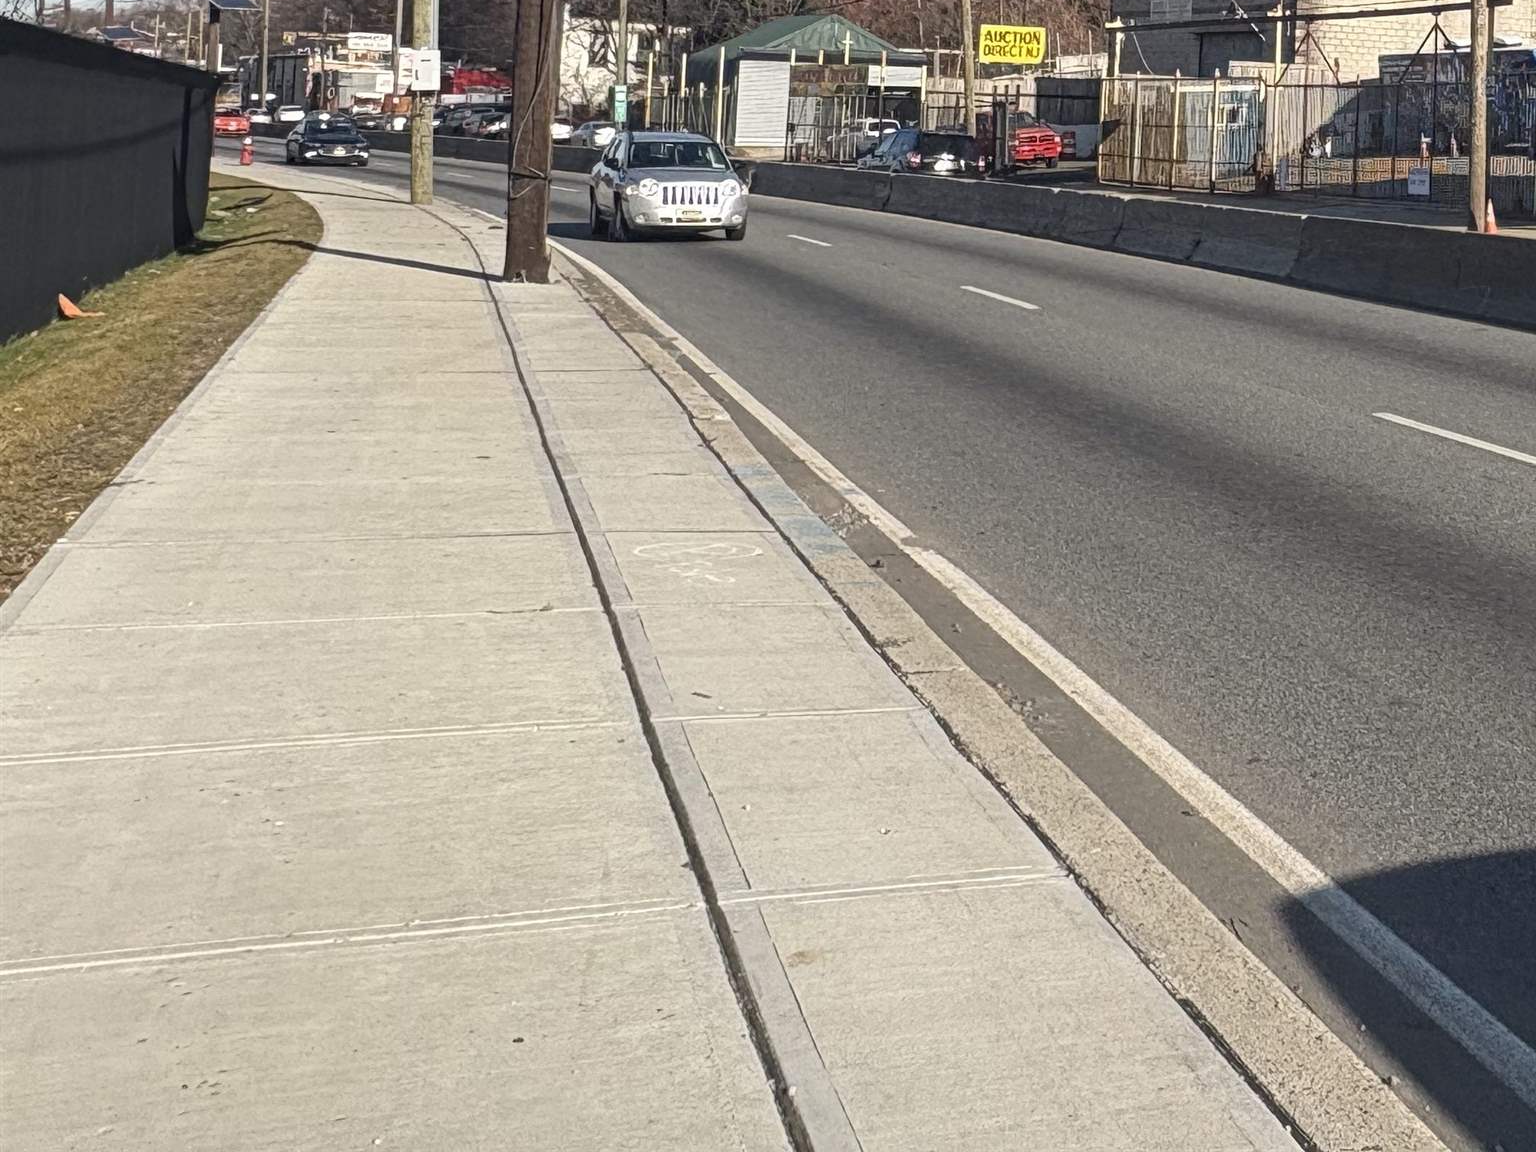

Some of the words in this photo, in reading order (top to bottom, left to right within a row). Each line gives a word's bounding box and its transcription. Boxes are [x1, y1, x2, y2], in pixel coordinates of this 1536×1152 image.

[983, 30, 1041, 46] AUCTION
[983, 44, 1024, 57] DIRECT
[1025, 46, 1040, 58] NJ
